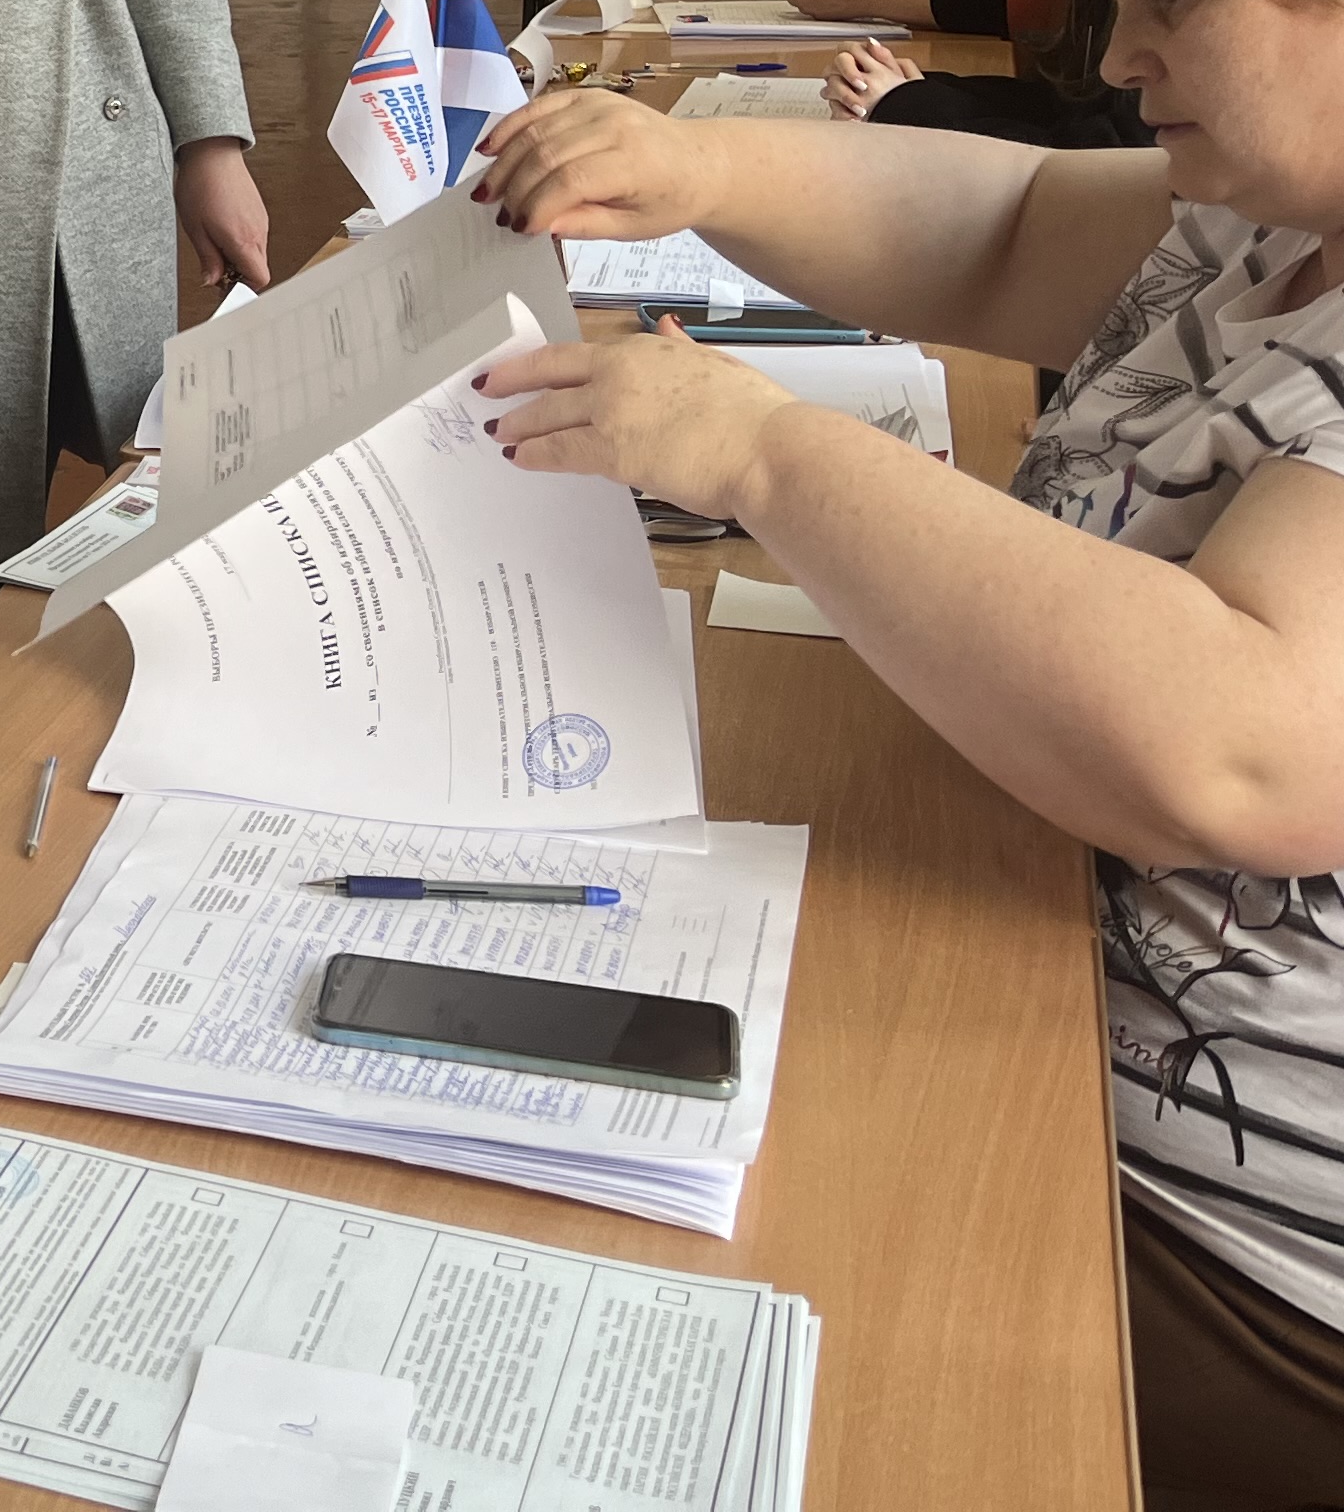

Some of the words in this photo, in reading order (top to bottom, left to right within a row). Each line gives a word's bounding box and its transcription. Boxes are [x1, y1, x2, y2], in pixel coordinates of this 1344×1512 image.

[378, 89, 417, 145] РОССИИ
[398, 85, 435, 176] ПРЕЗИДЕНТА
[414, 83, 435, 146] ВЫБОРЫ
[380, 120, 406, 158] МАРТА
[399, 155, 417, 182] 2024
[277, 515, 328, 606] СПИСКА
[330, 499, 371, 575] избирателей
[341, 560, 355, 575] об
[351, 578, 373, 651] сведениями
[366, 577, 384, 622] список
[209, 634, 221, 682] ВЫБОРЫ
[319, 611, 342, 690] КНИГА
[58, 1387, 89, 1431] ДАВАНКОВ
